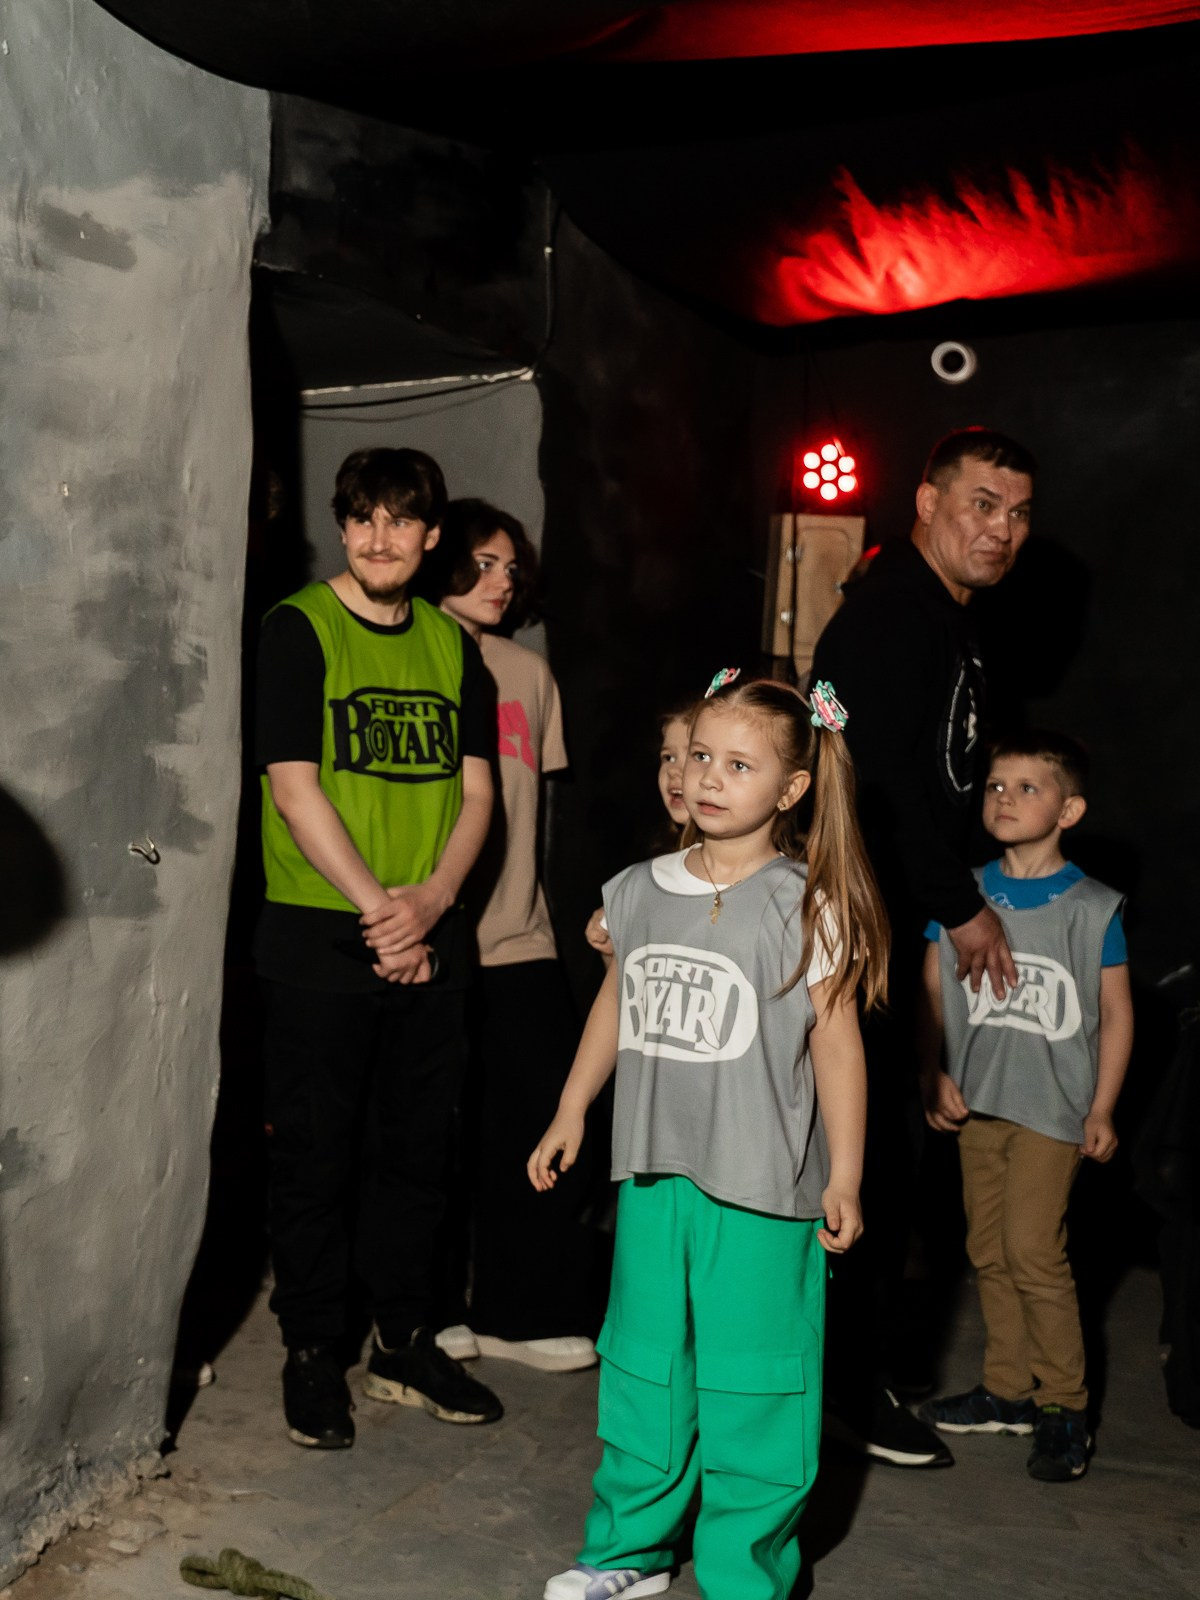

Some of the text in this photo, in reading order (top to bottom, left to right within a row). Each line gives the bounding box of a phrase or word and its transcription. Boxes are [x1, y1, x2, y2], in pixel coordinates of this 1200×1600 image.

[369, 698, 438, 718] FORT
[645, 957, 711, 985] ORT
[618, 962, 758, 1060] BYARD
